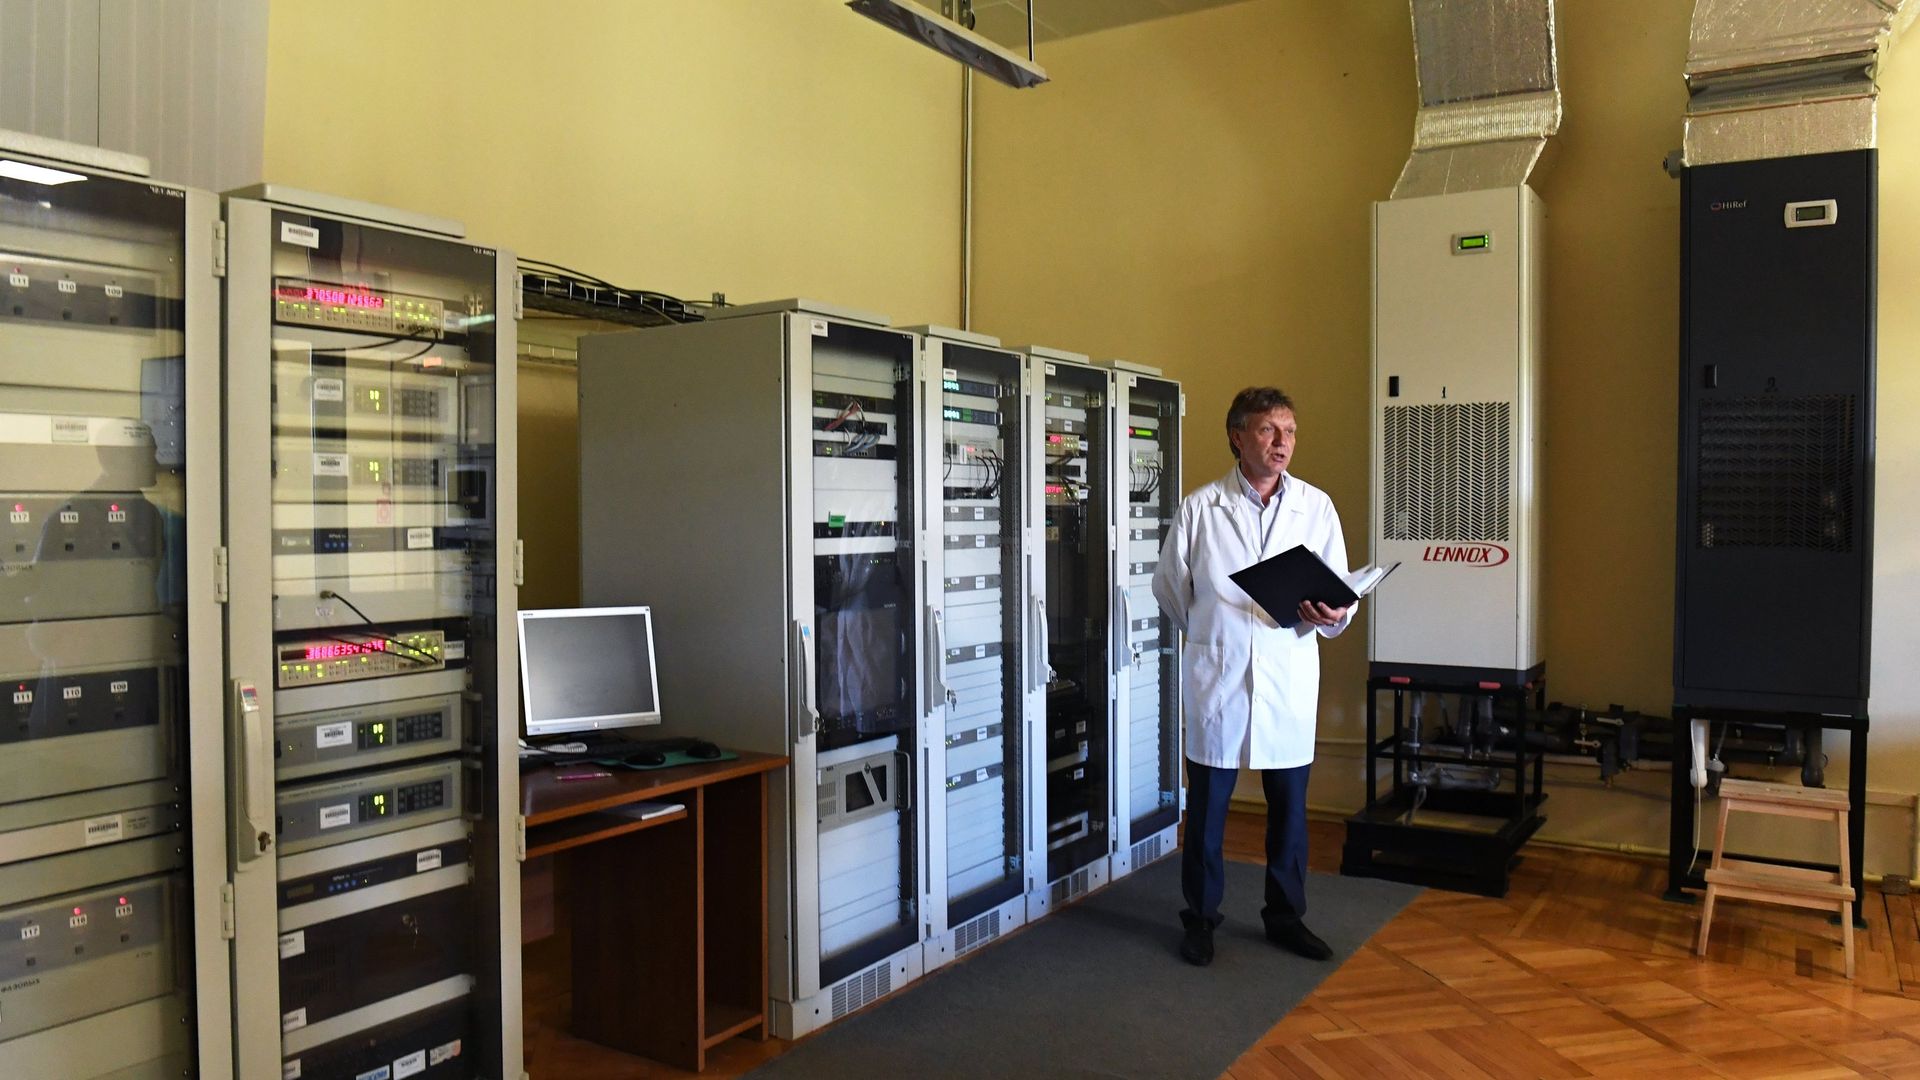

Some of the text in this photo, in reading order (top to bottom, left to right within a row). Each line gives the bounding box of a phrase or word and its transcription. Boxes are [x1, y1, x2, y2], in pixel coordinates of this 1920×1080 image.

[12, 276, 27, 286] 111
[60, 282, 75, 292] 110
[106, 287, 121, 296] 109
[1440, 385, 1447, 399] 1
[12, 513, 27, 522] 117
[62, 513, 77, 522] 116
[109, 512, 124, 521] 115
[1422, 546, 1492, 563] LENNOX
[15, 693, 31, 703] 111
[65, 688, 80, 698] 110
[23, 928, 38, 937] 117
